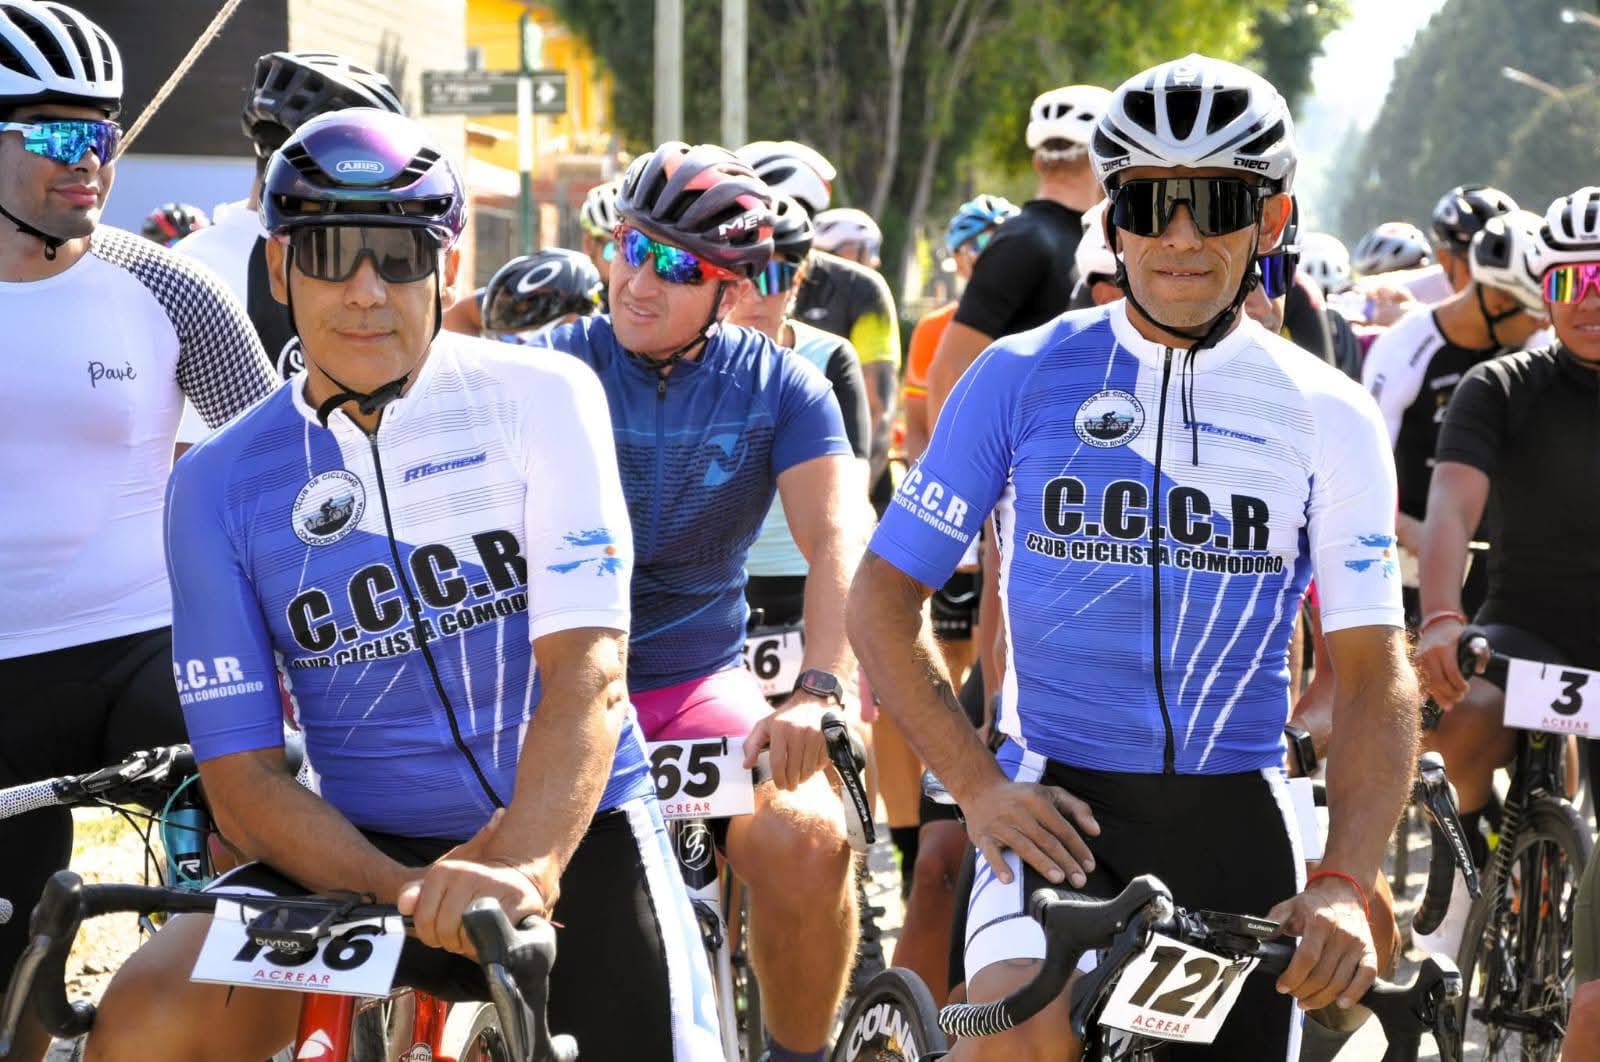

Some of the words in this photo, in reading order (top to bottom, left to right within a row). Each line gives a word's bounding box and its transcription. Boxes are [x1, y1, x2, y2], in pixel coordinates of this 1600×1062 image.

[343, 162, 378, 171] ABUS
[1042, 477, 1270, 552] C.C.C.R
[1027, 533, 1067, 560] CLUB
[1071, 540, 1171, 566] CICLISTA
[1176, 548, 1283, 575] COMODORO
[439, 591, 529, 637] COMOD
[194, 681, 264, 702] COMODORO
[1550, 669, 1590, 716] 3
[660, 801, 712, 814] CREAR
[1443, 816, 1473, 875] ULTEGRA
[1247, 922, 1274, 934] GARMIN
[254, 969, 332, 984] ACREAR
[1132, 1014, 1191, 1034] ACREAR
